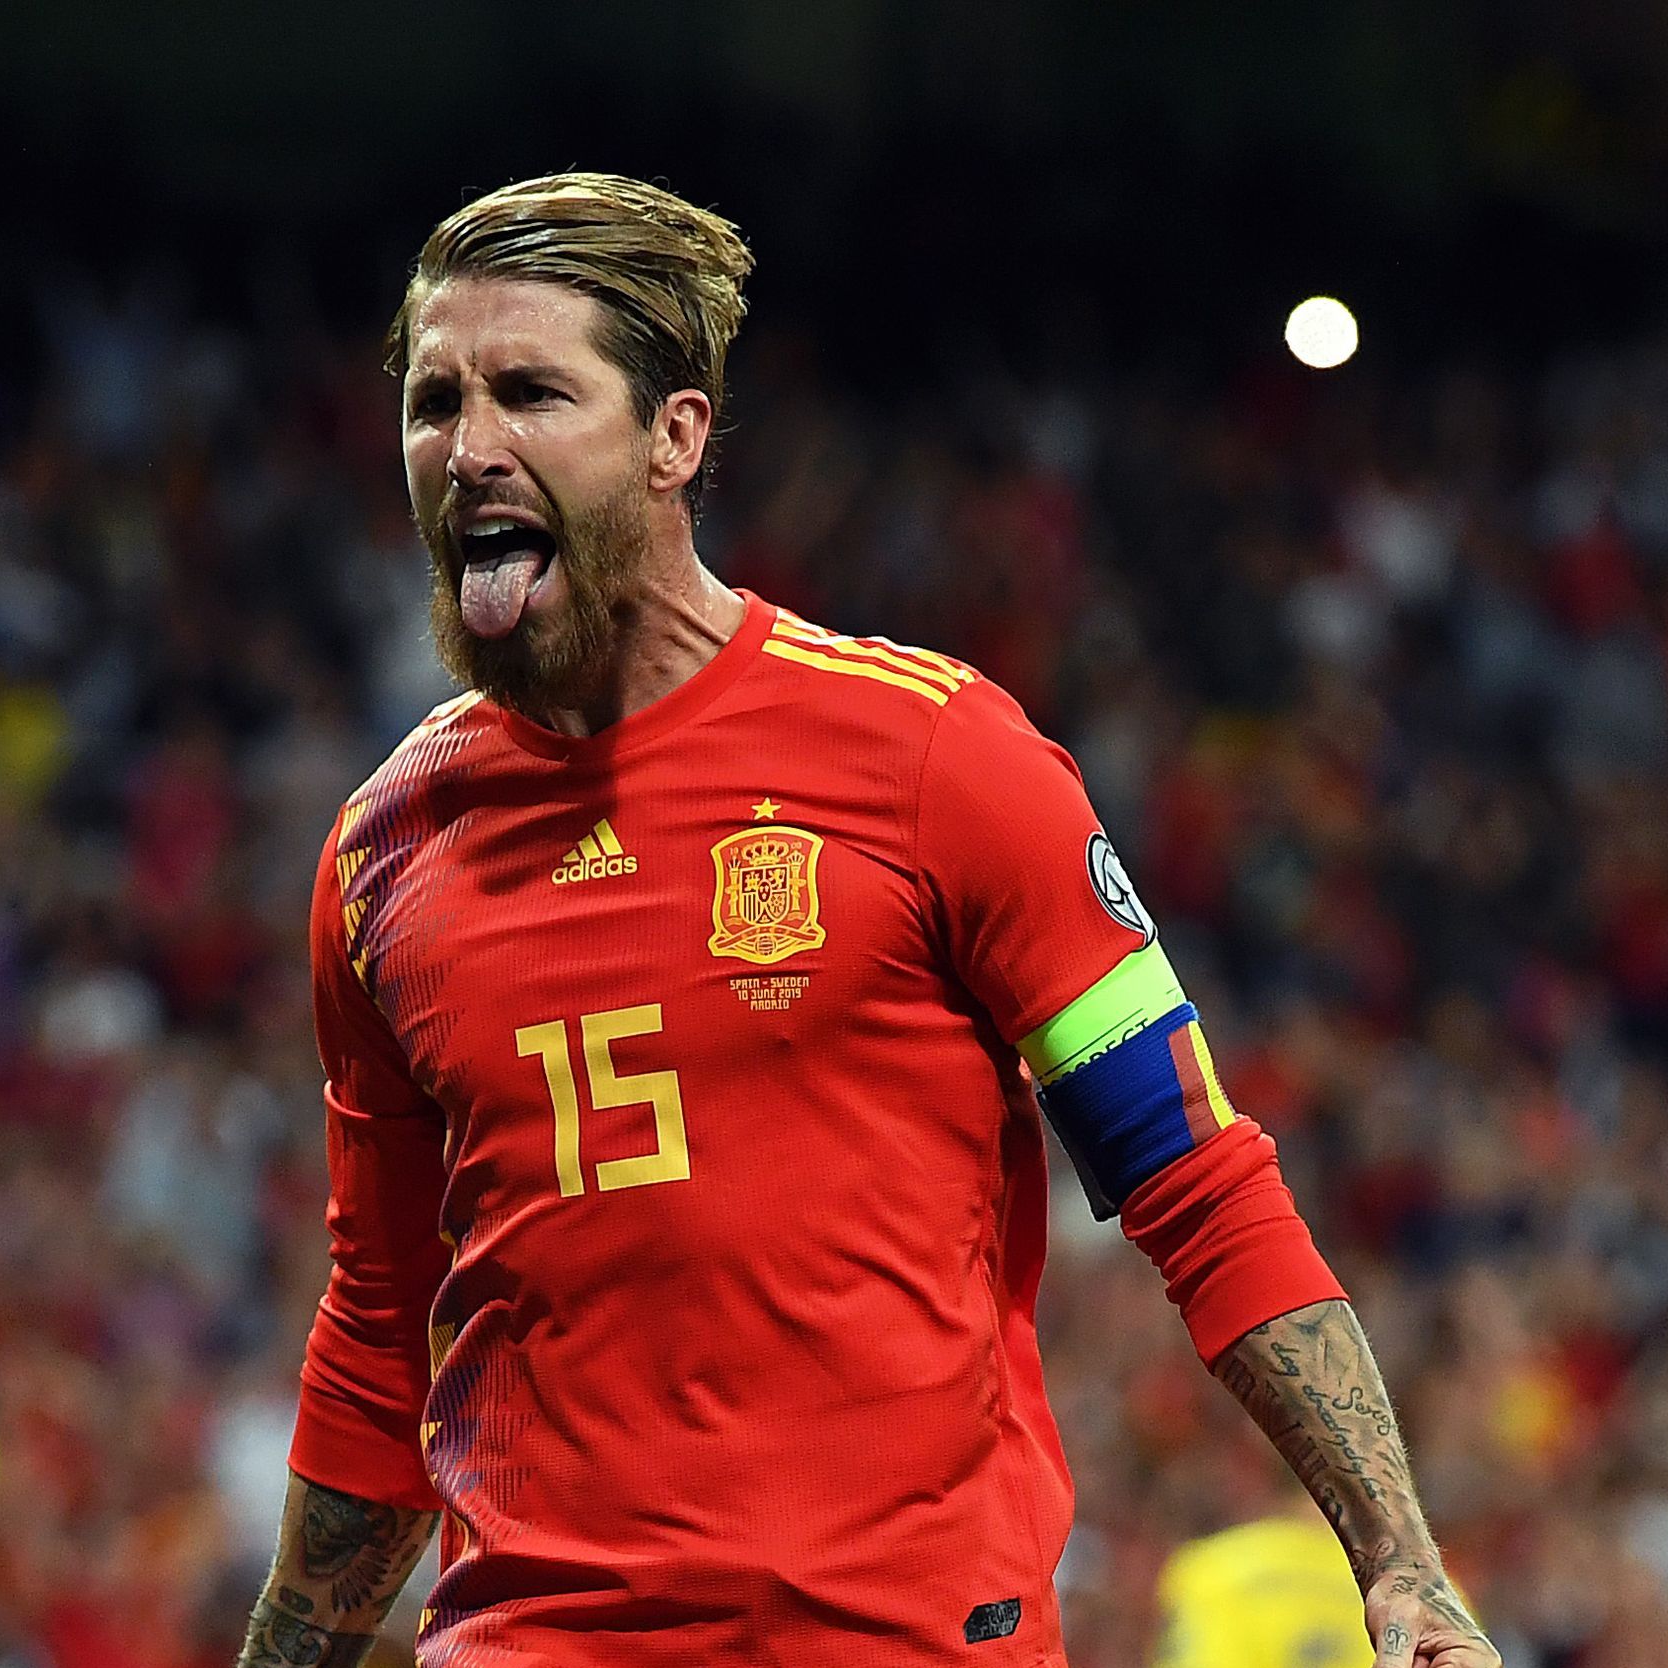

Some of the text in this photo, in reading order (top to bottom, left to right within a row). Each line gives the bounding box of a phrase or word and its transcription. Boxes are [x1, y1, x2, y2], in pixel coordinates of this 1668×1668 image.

[551, 854, 638, 885] adidas
[730, 978, 761, 991] SPAIN
[770, 976, 810, 988] SWEDEN
[737, 988, 802, 1000] 10 JUNE 2019
[750, 999, 790, 1011] MADRID
[515, 1002, 691, 1198] 15
